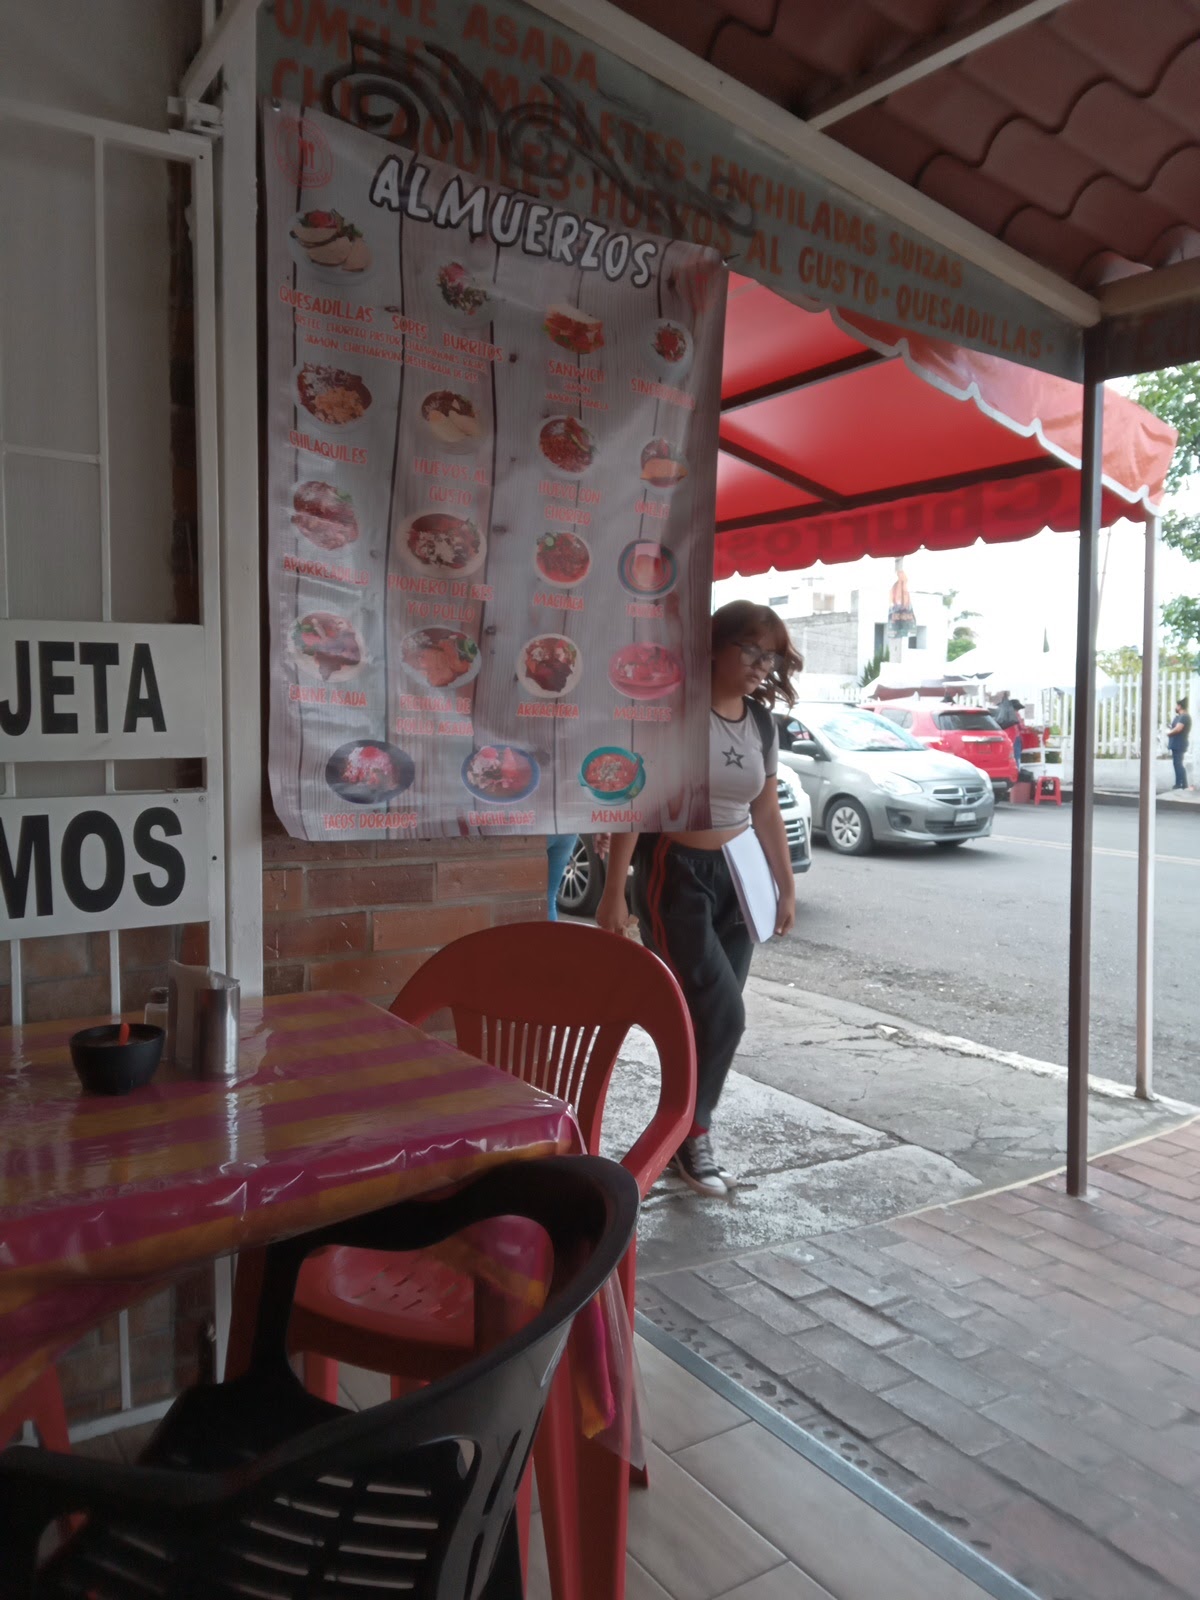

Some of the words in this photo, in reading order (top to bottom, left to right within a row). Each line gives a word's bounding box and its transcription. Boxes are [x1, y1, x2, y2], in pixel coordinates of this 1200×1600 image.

[462, 4, 598, 92] ASADA
[368, 153, 659, 288] ALMUERZOS
[710, 155, 878, 257] ENCHILADAS
[887, 233, 963, 289] SUIZAS
[279, 285, 375, 323] QUESADILLAS
[746, 230, 783, 277] AL
[799, 245, 880, 306] GUSTO
[897, 285, 1042, 360] QUESADILLAS
[391, 314, 428, 340] SOPES
[442, 332, 504, 363] BURRITOS
[547, 359, 606, 383] SANWICH
[288, 430, 369, 465] CHILAQUILES
[413, 456, 470, 481] HUEVOS
[472, 467, 489, 486] AL
[428, 485, 473, 507] GUSTO
[537, 479, 577, 501] HUEVO
[578, 487, 602, 505] CON
[543, 504, 592, 527] CHORIZO
[451, 581, 468, 598] DE
[533, 591, 585, 611] MACHACA
[432, 603, 476, 623] POLLO
[0, 640, 167, 736] JETA
[288, 683, 327, 704] CARNE
[329, 688, 368, 707] ASADA
[399, 693, 453, 713] PECHUGA
[455, 696, 472, 715] DE
[613, 704, 673, 722] MOLLETES
[395, 717, 435, 736] POLLO
[322, 812, 356, 831] TACOS
[359, 811, 418, 829] DORADOS
[468, 809, 536, 827] ENCHILADAS
[590, 809, 643, 824] MENUDO
[0, 806, 186, 919] MOS
